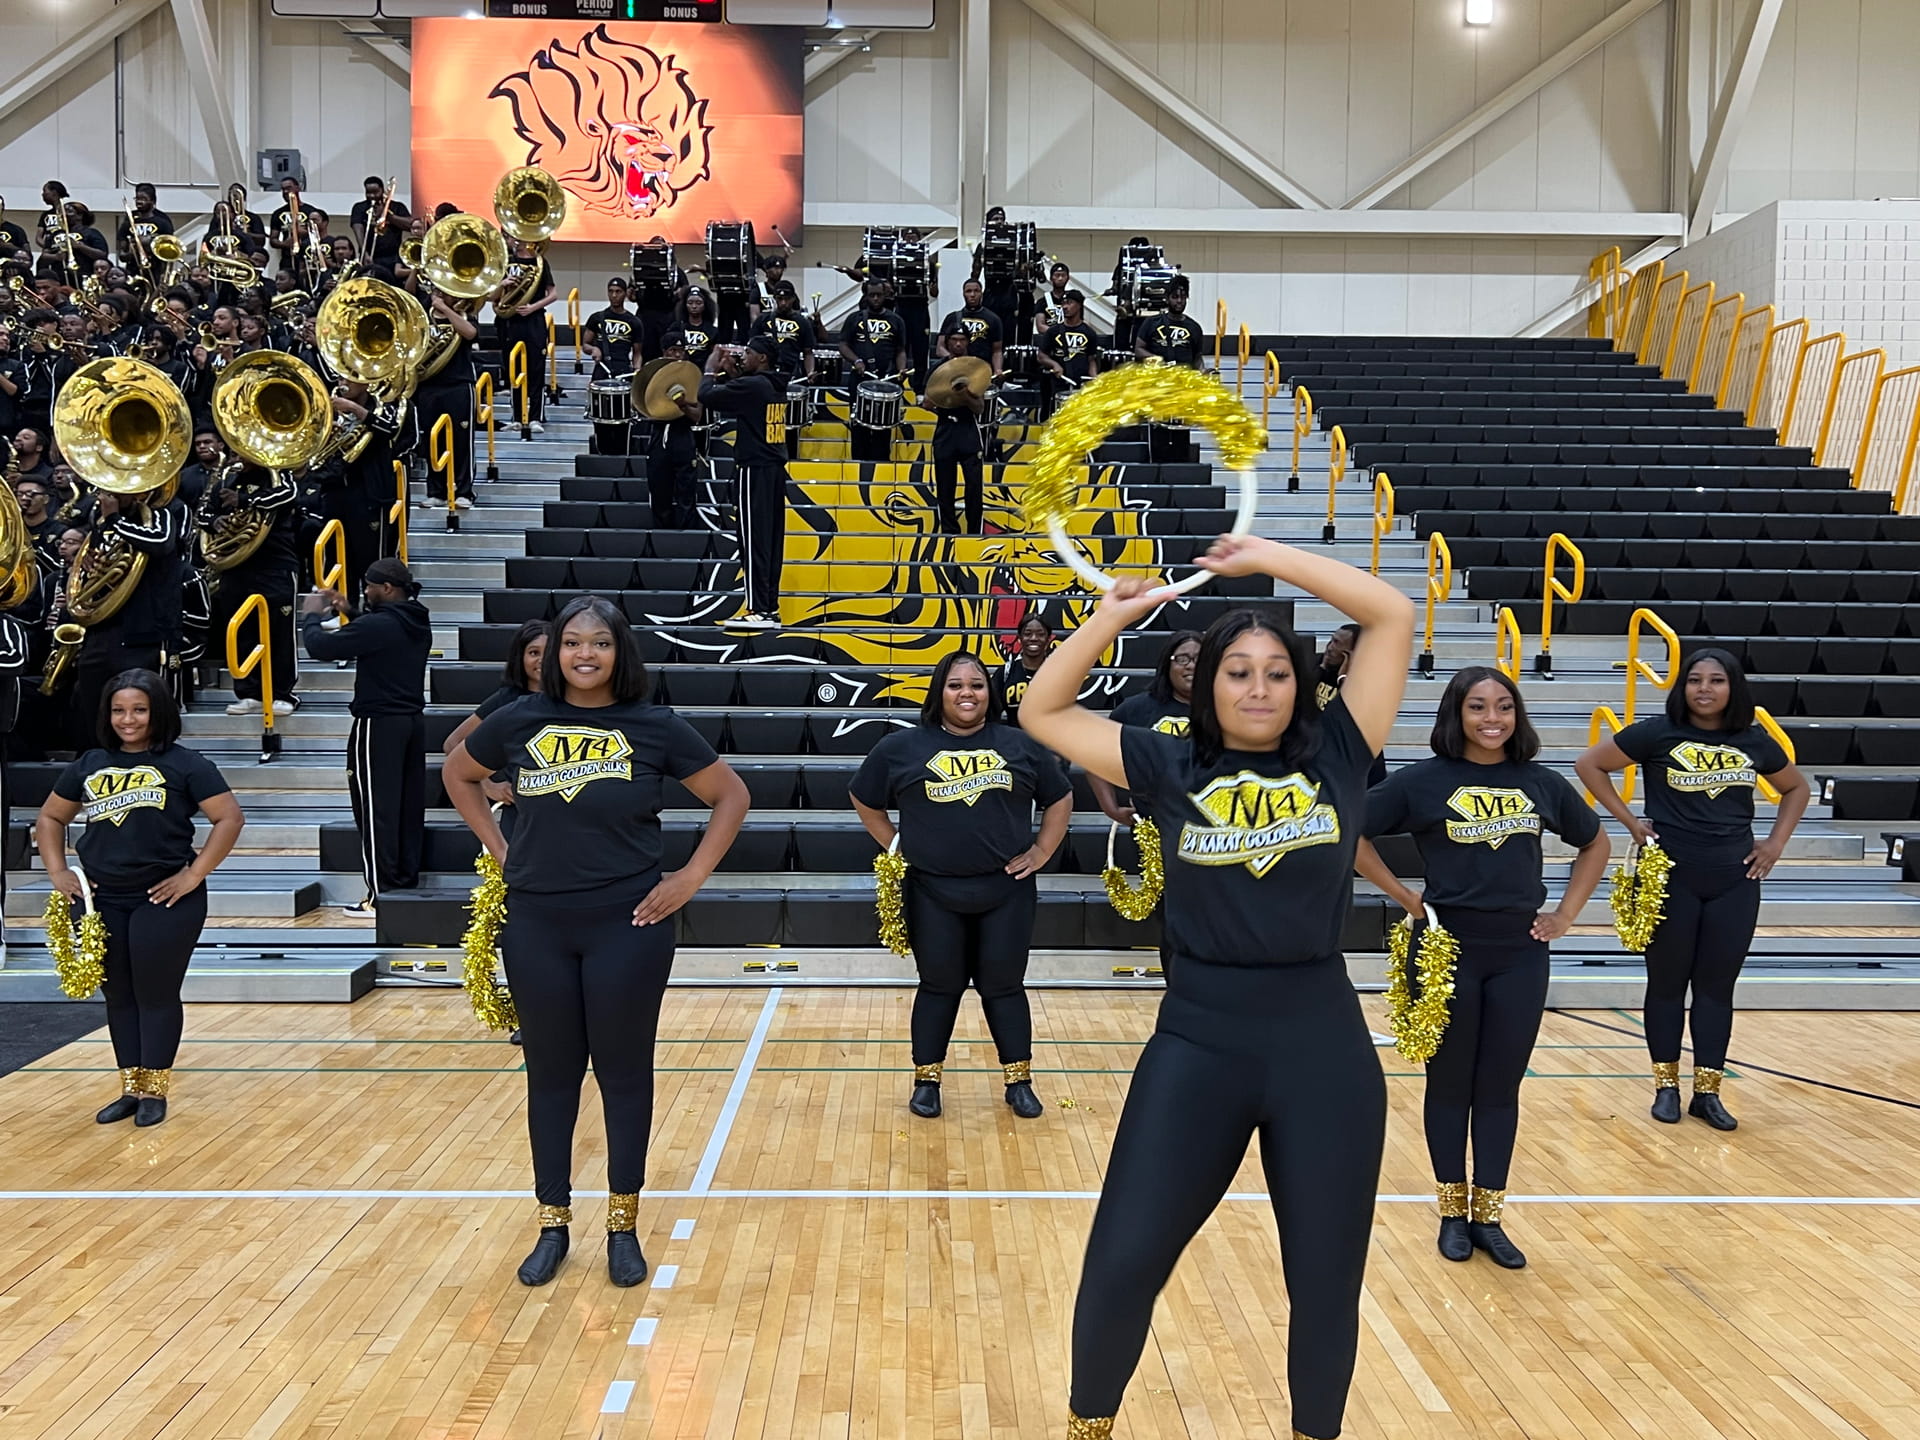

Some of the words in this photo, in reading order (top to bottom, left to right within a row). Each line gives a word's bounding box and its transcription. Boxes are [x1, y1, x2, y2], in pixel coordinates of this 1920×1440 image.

[512, 4, 547, 15] BONUS
[578, 0, 614, 9] PERIOD
[663, 7, 698, 18] BONUS
[605, 322, 626, 333] M4
[548, 735, 610, 764] M4
[948, 755, 993, 777] M4
[1696, 751, 1740, 770] M4
[97, 773, 147, 795] M4
[520, 776, 529, 789] 24
[529, 772, 559, 789] KARAT
[560, 762, 601, 782] GOLDEN
[601, 761, 628, 773] SILKS
[1680, 776, 1704, 785] KARAT
[1706, 773, 1738, 784] GOLDEN
[929, 787, 938, 797] 24
[938, 784, 960, 797] KARAT
[961, 775, 991, 791] GOLDEN
[992, 774, 1010, 785] SILKS
[108, 792, 139, 810] GOLDEN
[140, 791, 162, 802] SILKS
[1228, 787, 1297, 829] M4
[1472, 795, 1520, 818] M4
[1451, 827, 1460, 836] 24
[1461, 825, 1486, 837] KARAT
[1487, 818, 1518, 833] GOLDEN
[1520, 818, 1538, 828] SILKS
[1183, 832, 1197, 852] 24
[1199, 832, 1243, 853] KARAT
[1244, 824, 1301, 849] GOLDEN
